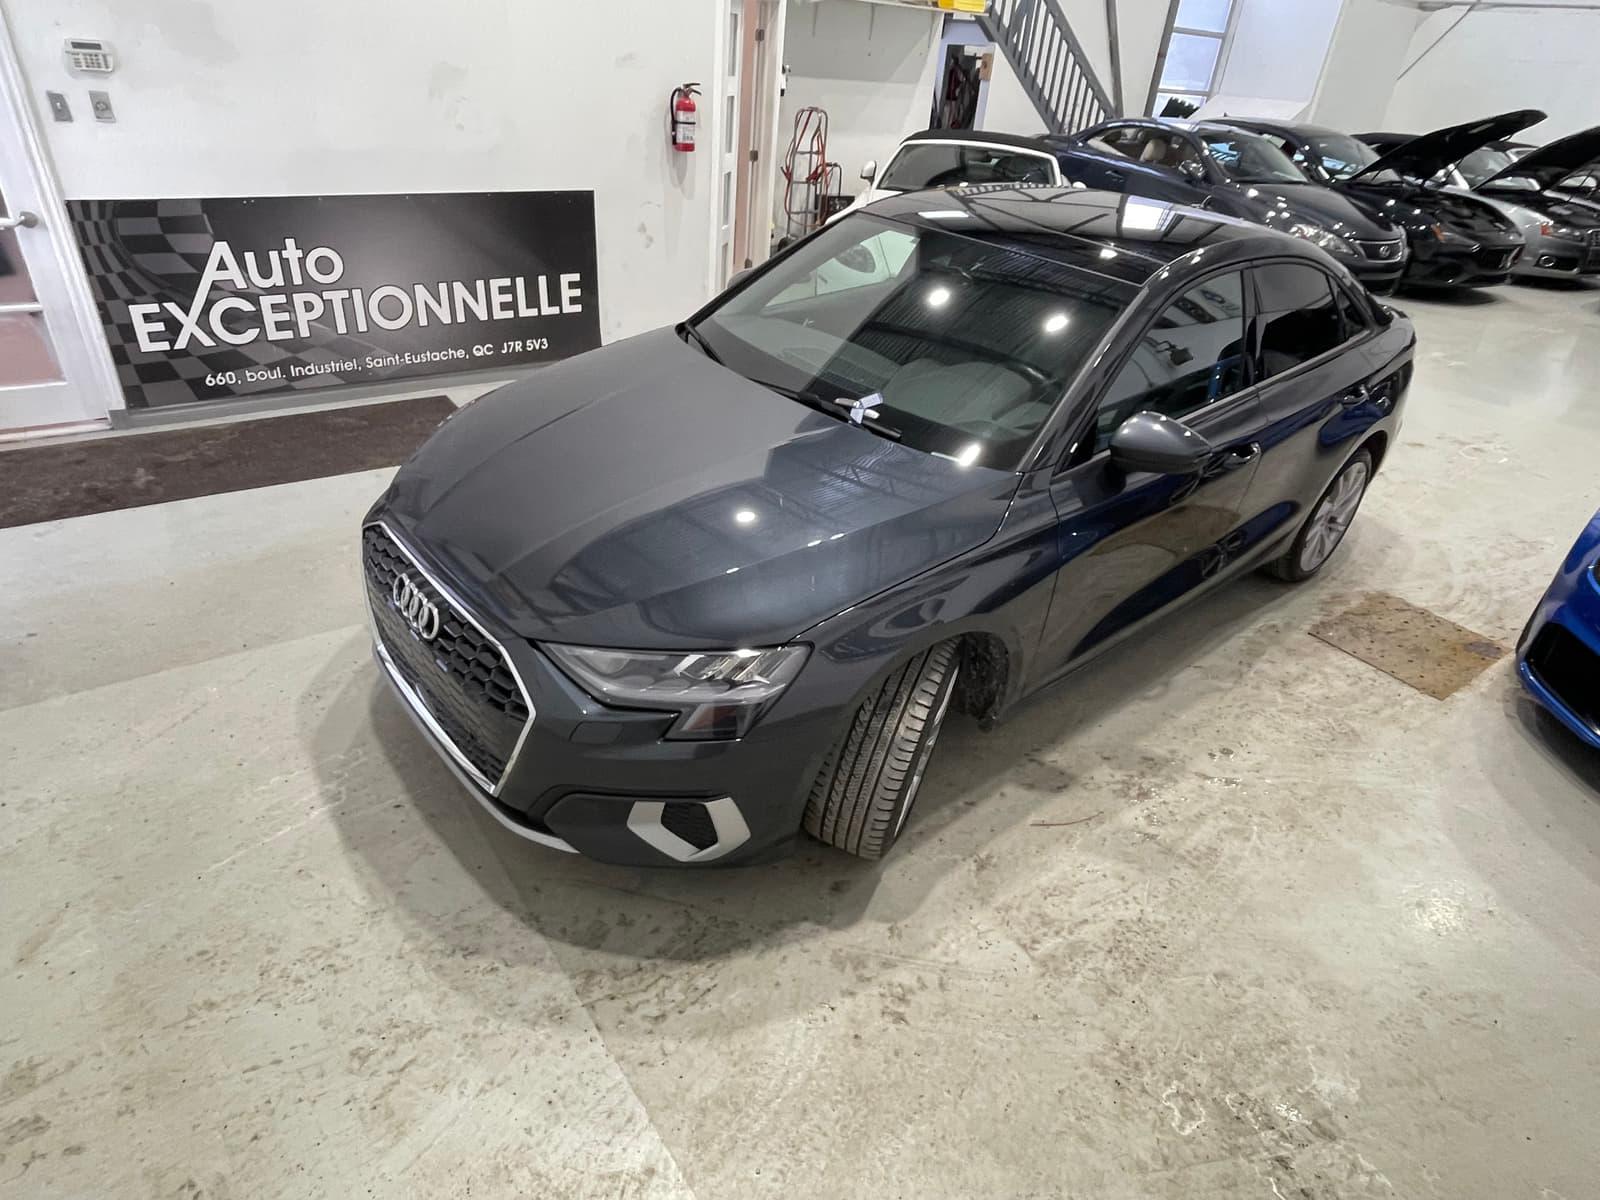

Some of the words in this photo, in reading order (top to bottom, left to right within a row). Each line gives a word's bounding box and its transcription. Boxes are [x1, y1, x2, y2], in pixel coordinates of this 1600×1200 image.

[199, 238, 344, 289] Auto
[127, 272, 584, 353] EXCEPTIONNELLE
[205, 371, 242, 387] 660,
[244, 367, 287, 382] boul.
[290, 359, 362, 378] Industriel,
[365, 350, 469, 369] Saint-Eustache,
[472, 343, 494, 357] QC
[501, 339, 523, 354] J7R
[525, 337, 549, 351] 5V3
